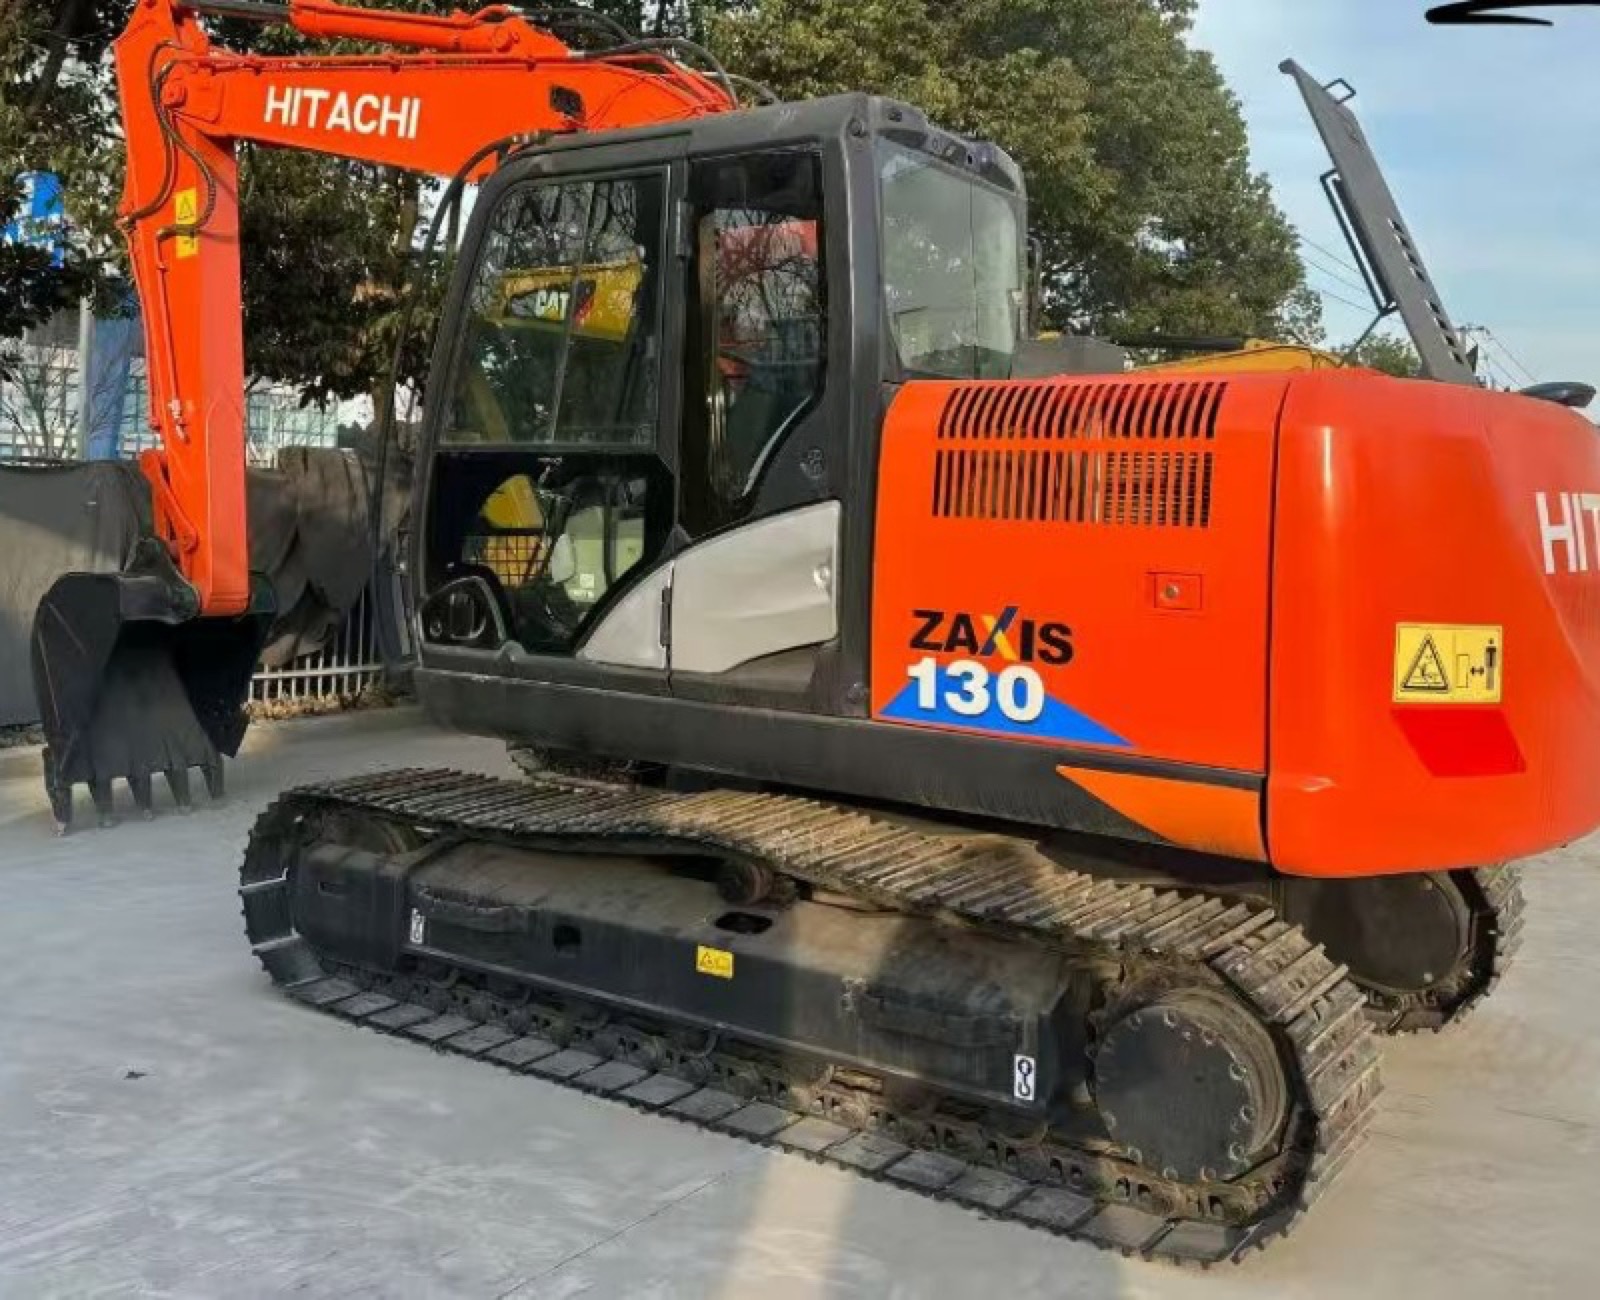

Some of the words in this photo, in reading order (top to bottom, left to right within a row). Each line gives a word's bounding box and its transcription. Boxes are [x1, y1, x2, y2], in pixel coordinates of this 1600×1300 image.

[263, 85, 421, 139] HITACHI
[535, 289, 571, 321] CAT
[909, 605, 1074, 665] ZAXIS
[907, 656, 1045, 724] 130
